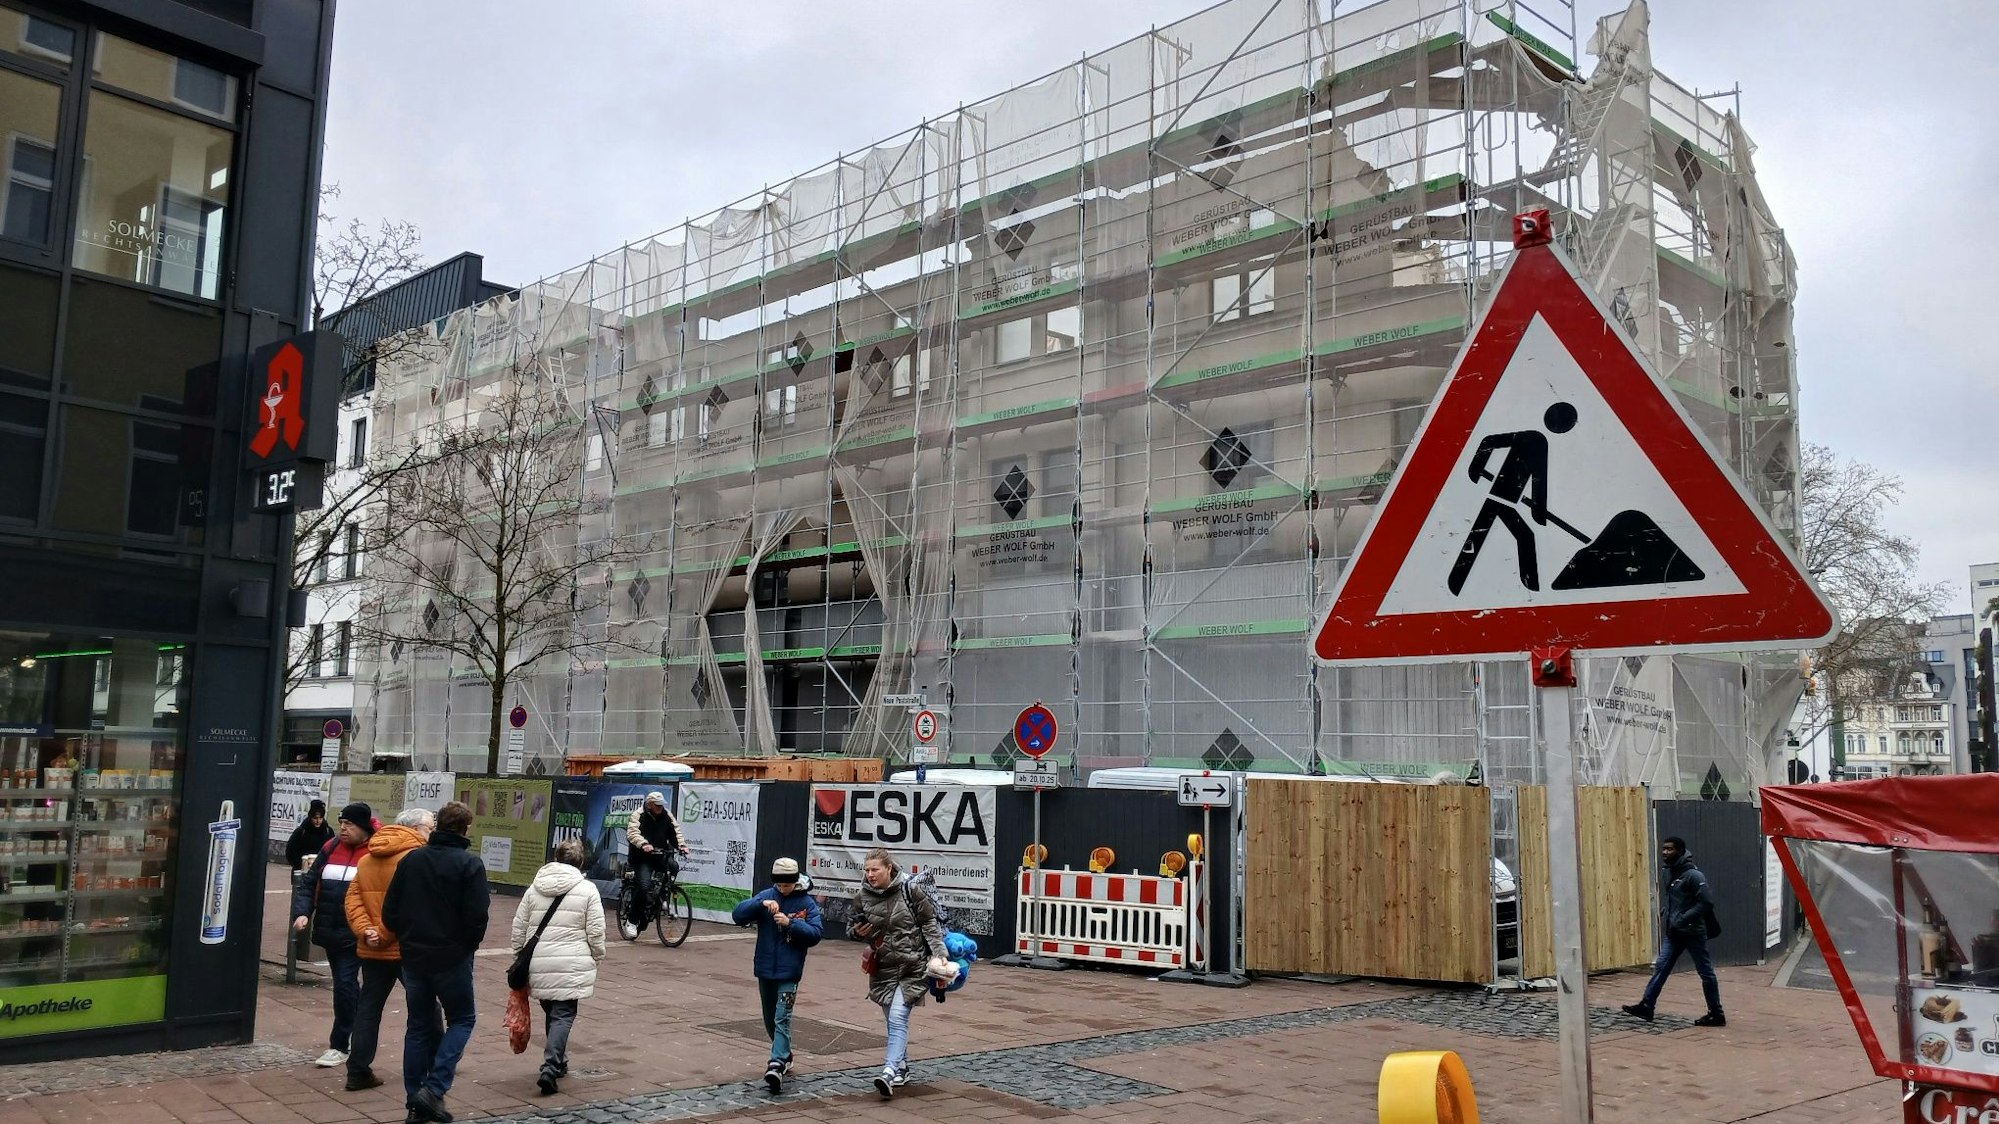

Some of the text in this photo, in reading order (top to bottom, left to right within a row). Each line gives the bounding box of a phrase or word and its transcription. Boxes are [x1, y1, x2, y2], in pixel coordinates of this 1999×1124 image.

[1350, 204, 1417, 234] GERÜSTBAU
[108, 220, 196, 253] SOLMECKE
[1172, 224, 1208, 246] WEBER
[1323, 235, 1368, 256] WEBER
[992, 265, 1038, 285] GERÜSTBAU
[972, 288, 1003, 302] WEBER
[1005, 279, 1029, 294] WOLF
[1353, 326, 1420, 348] WEBER WOLF
[1198, 360, 1254, 380] WEBER WOLF
[993, 404, 1036, 420] WEBER WOLF
[1353, 473, 1391, 485] WEBER
[1198, 492, 1228, 503] WEBER
[1172, 511, 1278, 530] WEBER WOLF GmbH
[1184, 526, 1270, 542] www.weber-wolf.de
[971, 541, 1055, 558] WEBER WOLF GmbH
[980, 554, 1048, 567] www.weber-wolf.de
[1199, 624, 1254, 636] WEBER WOLF
[990, 637, 1033, 647] WEBER WOLF
[1614, 686, 1656, 703] GERÜSTBAU
[1595, 698, 1672, 722] WEBER WOLF GmbH
[210, 728, 248, 736] SOLMECKE
[1360, 763, 1428, 775] WEBER WOLF
[420, 782, 441, 798] EHSF
[271, 803, 294, 819] ESKA
[703, 800, 751, 821] ERA-SOLAR
[849, 790, 989, 846] ESKA
[814, 822, 842, 836] ESKA
[820, 859, 834, 868] Erd-
[836, 861, 843, 869] u.
[0, 997, 93, 1020] Apotheke
